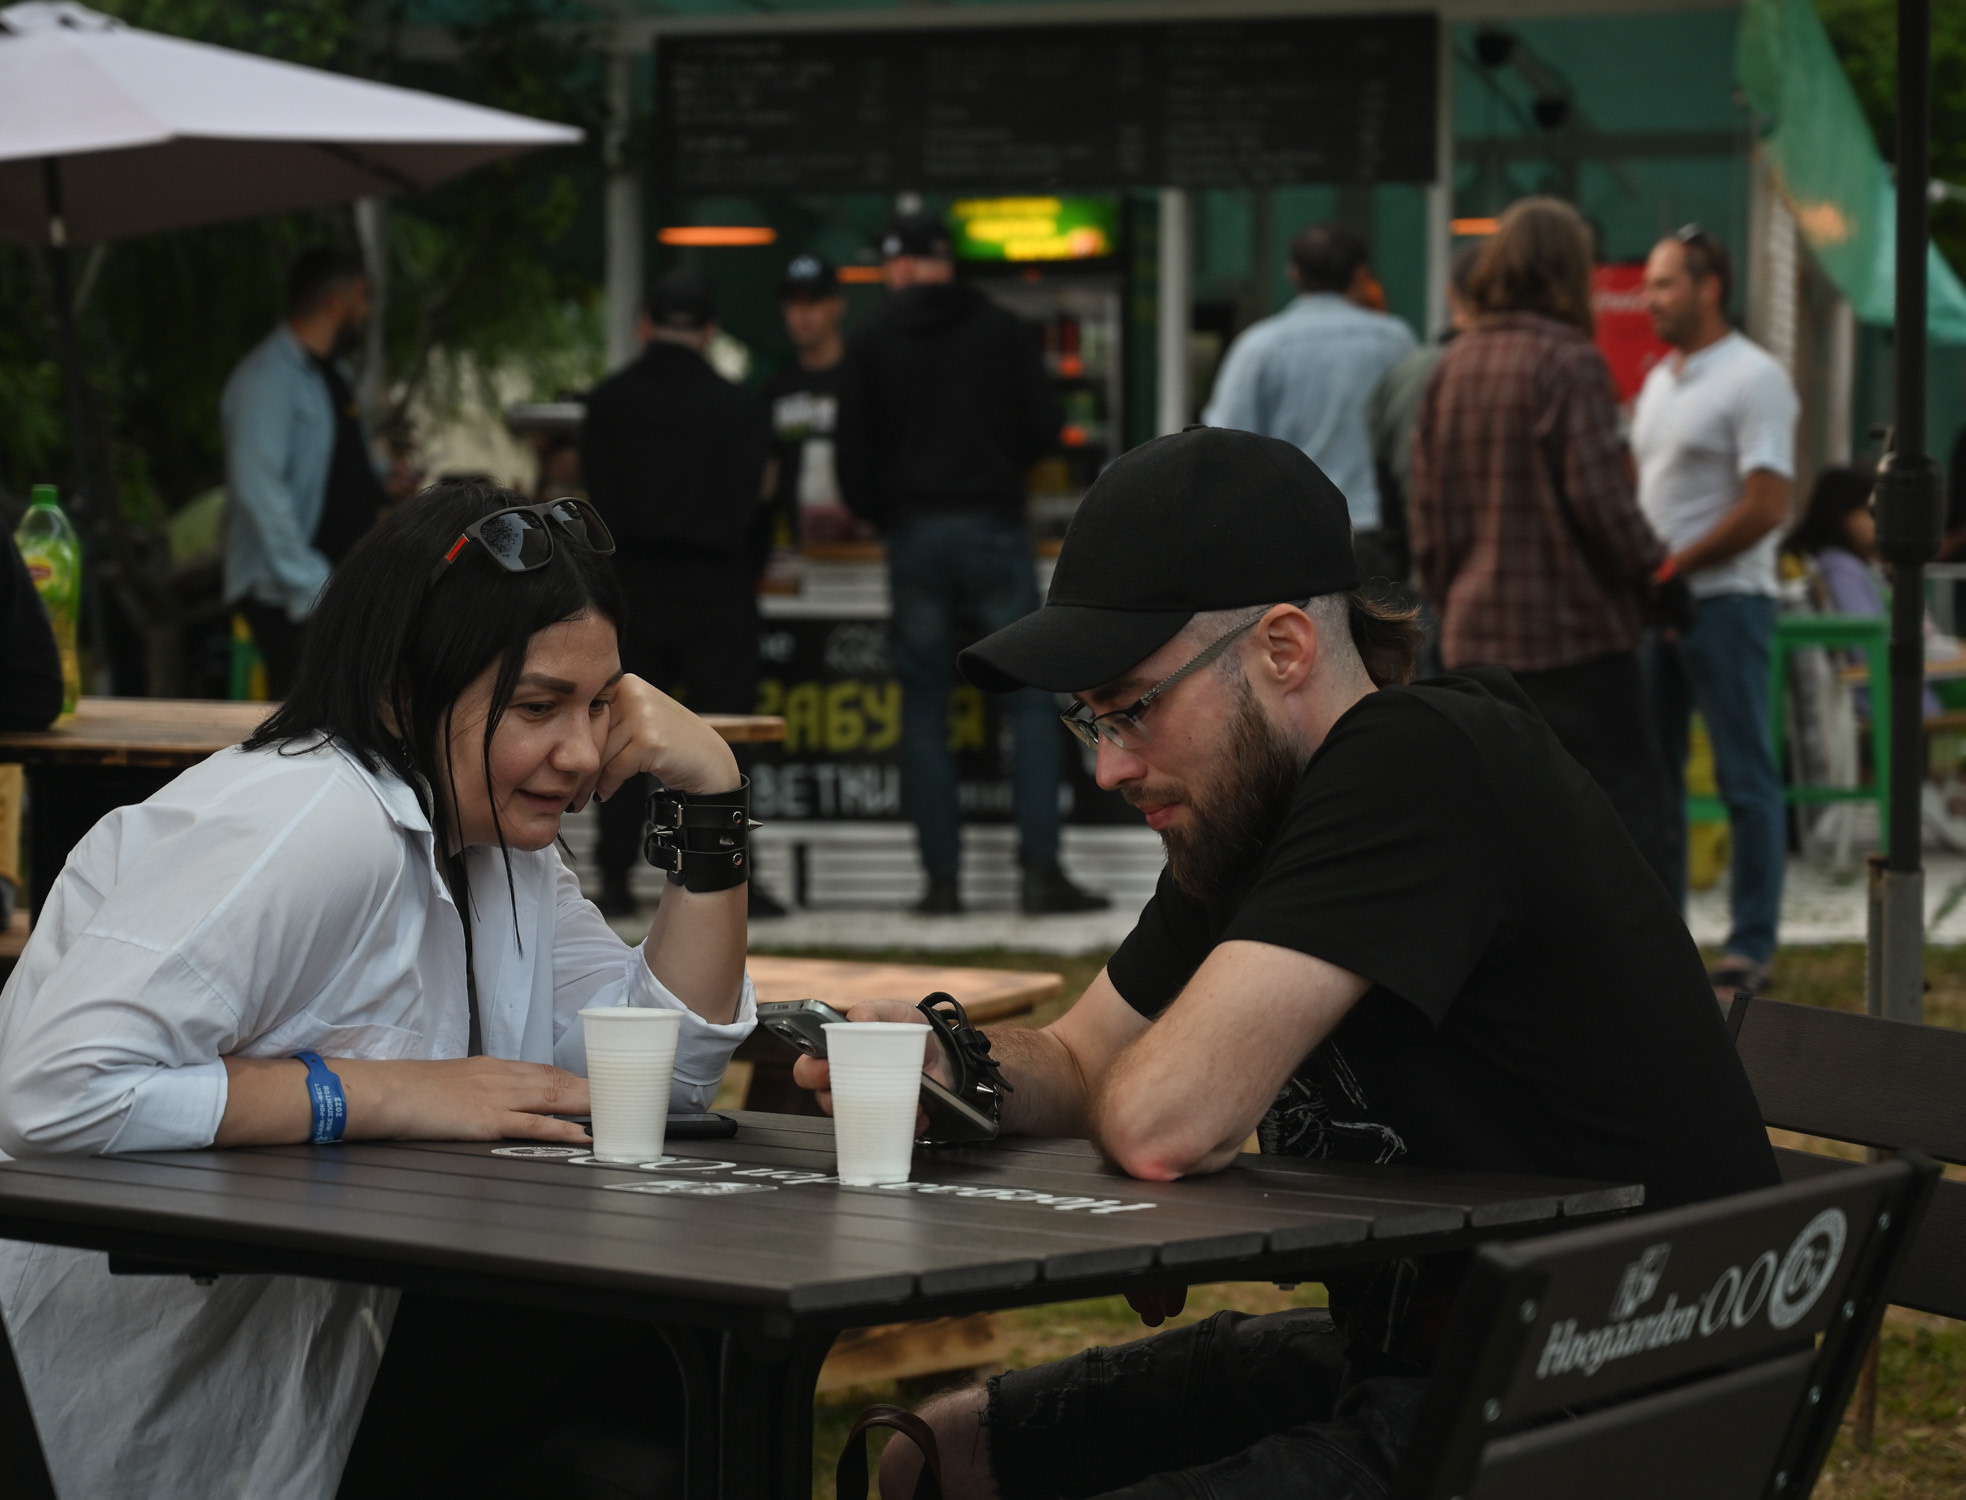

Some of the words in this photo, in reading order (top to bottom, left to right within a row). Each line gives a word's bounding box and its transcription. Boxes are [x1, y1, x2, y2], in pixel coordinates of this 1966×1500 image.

[333, 1096, 343, 1117] 2023
[731, 1167, 1158, 1214] Hoegaaden
[1537, 1294, 1699, 1378] Hoegaarden
